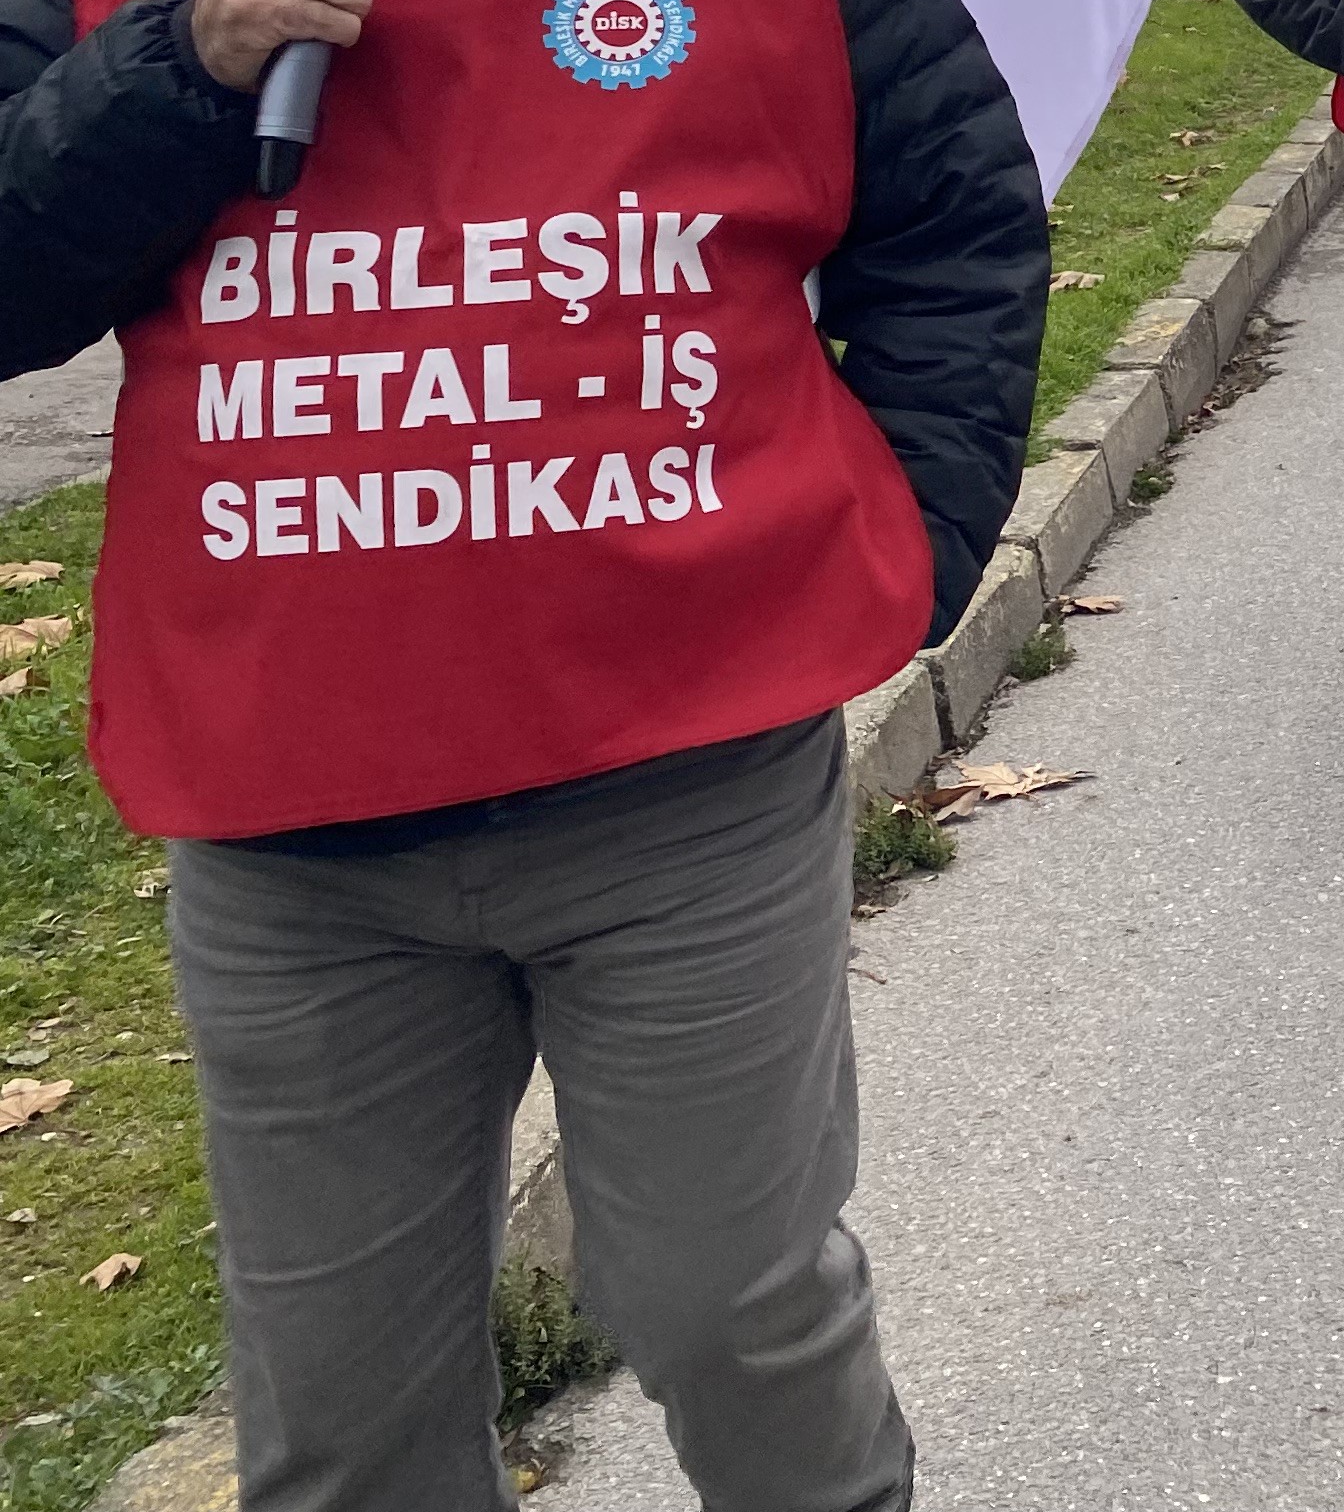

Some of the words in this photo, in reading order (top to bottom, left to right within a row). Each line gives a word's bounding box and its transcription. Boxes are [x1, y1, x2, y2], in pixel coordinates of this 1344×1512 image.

[595, 10, 645, 31] DİSK
[200, 191, 724, 325] BİRLEŞİK
[197, 343, 542, 444] METAL
[640, 314, 719, 430] İŞ
[200, 444, 724, 561] SENDİKASI
